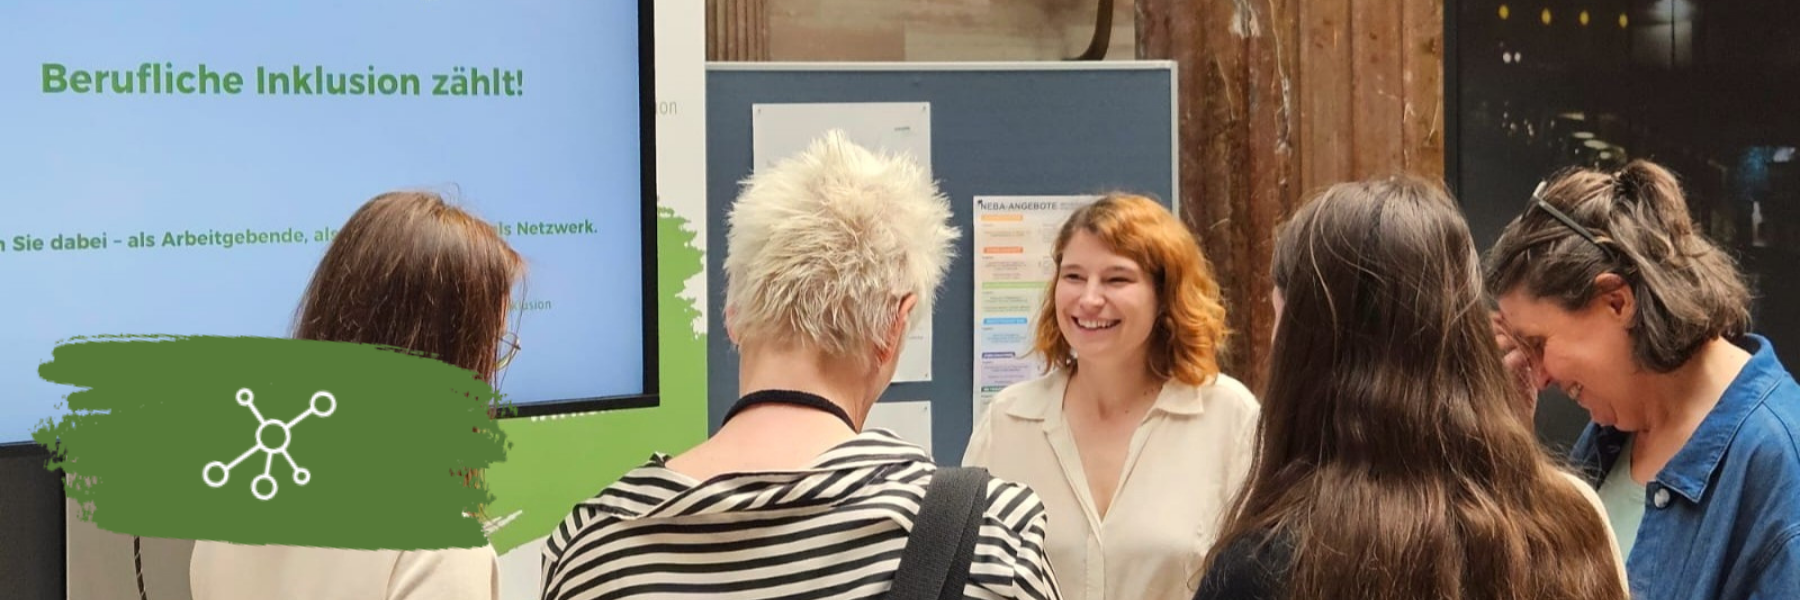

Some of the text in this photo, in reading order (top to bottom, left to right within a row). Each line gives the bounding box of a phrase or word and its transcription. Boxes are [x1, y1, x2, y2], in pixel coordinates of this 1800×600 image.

[41, 62, 524, 97] Berufliche Inklusion zählt!
[12, 233, 44, 252] Sie
[50, 233, 107, 251] dabei
[127, 231, 156, 248] als
[161, 227, 308, 248] Arbeitgebende,
[517, 219, 598, 236] Netzwerk.
